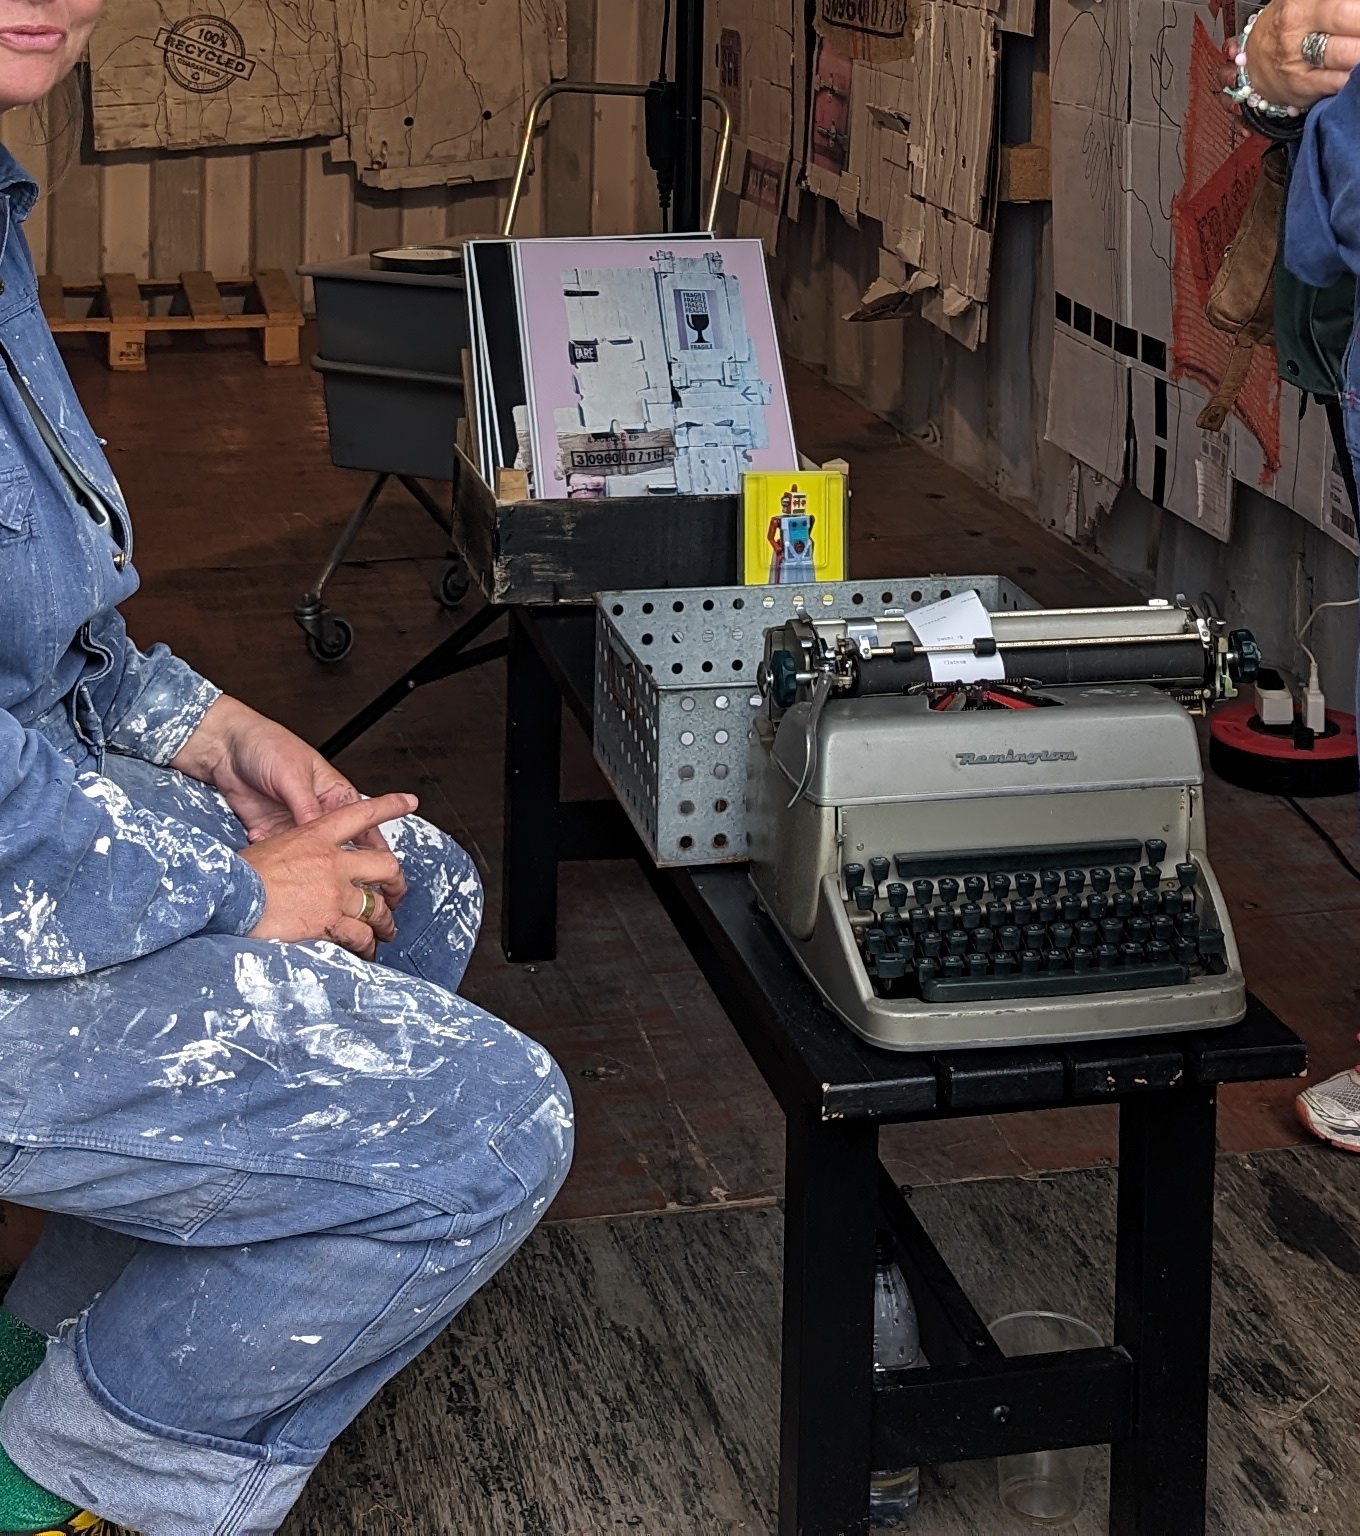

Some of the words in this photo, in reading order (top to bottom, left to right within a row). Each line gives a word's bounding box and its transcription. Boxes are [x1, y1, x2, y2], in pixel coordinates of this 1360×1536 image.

[198, 27, 229, 48] 100%
[164, 35, 246, 73] RECYCLED
[955, 749, 1077, 765] Remington
